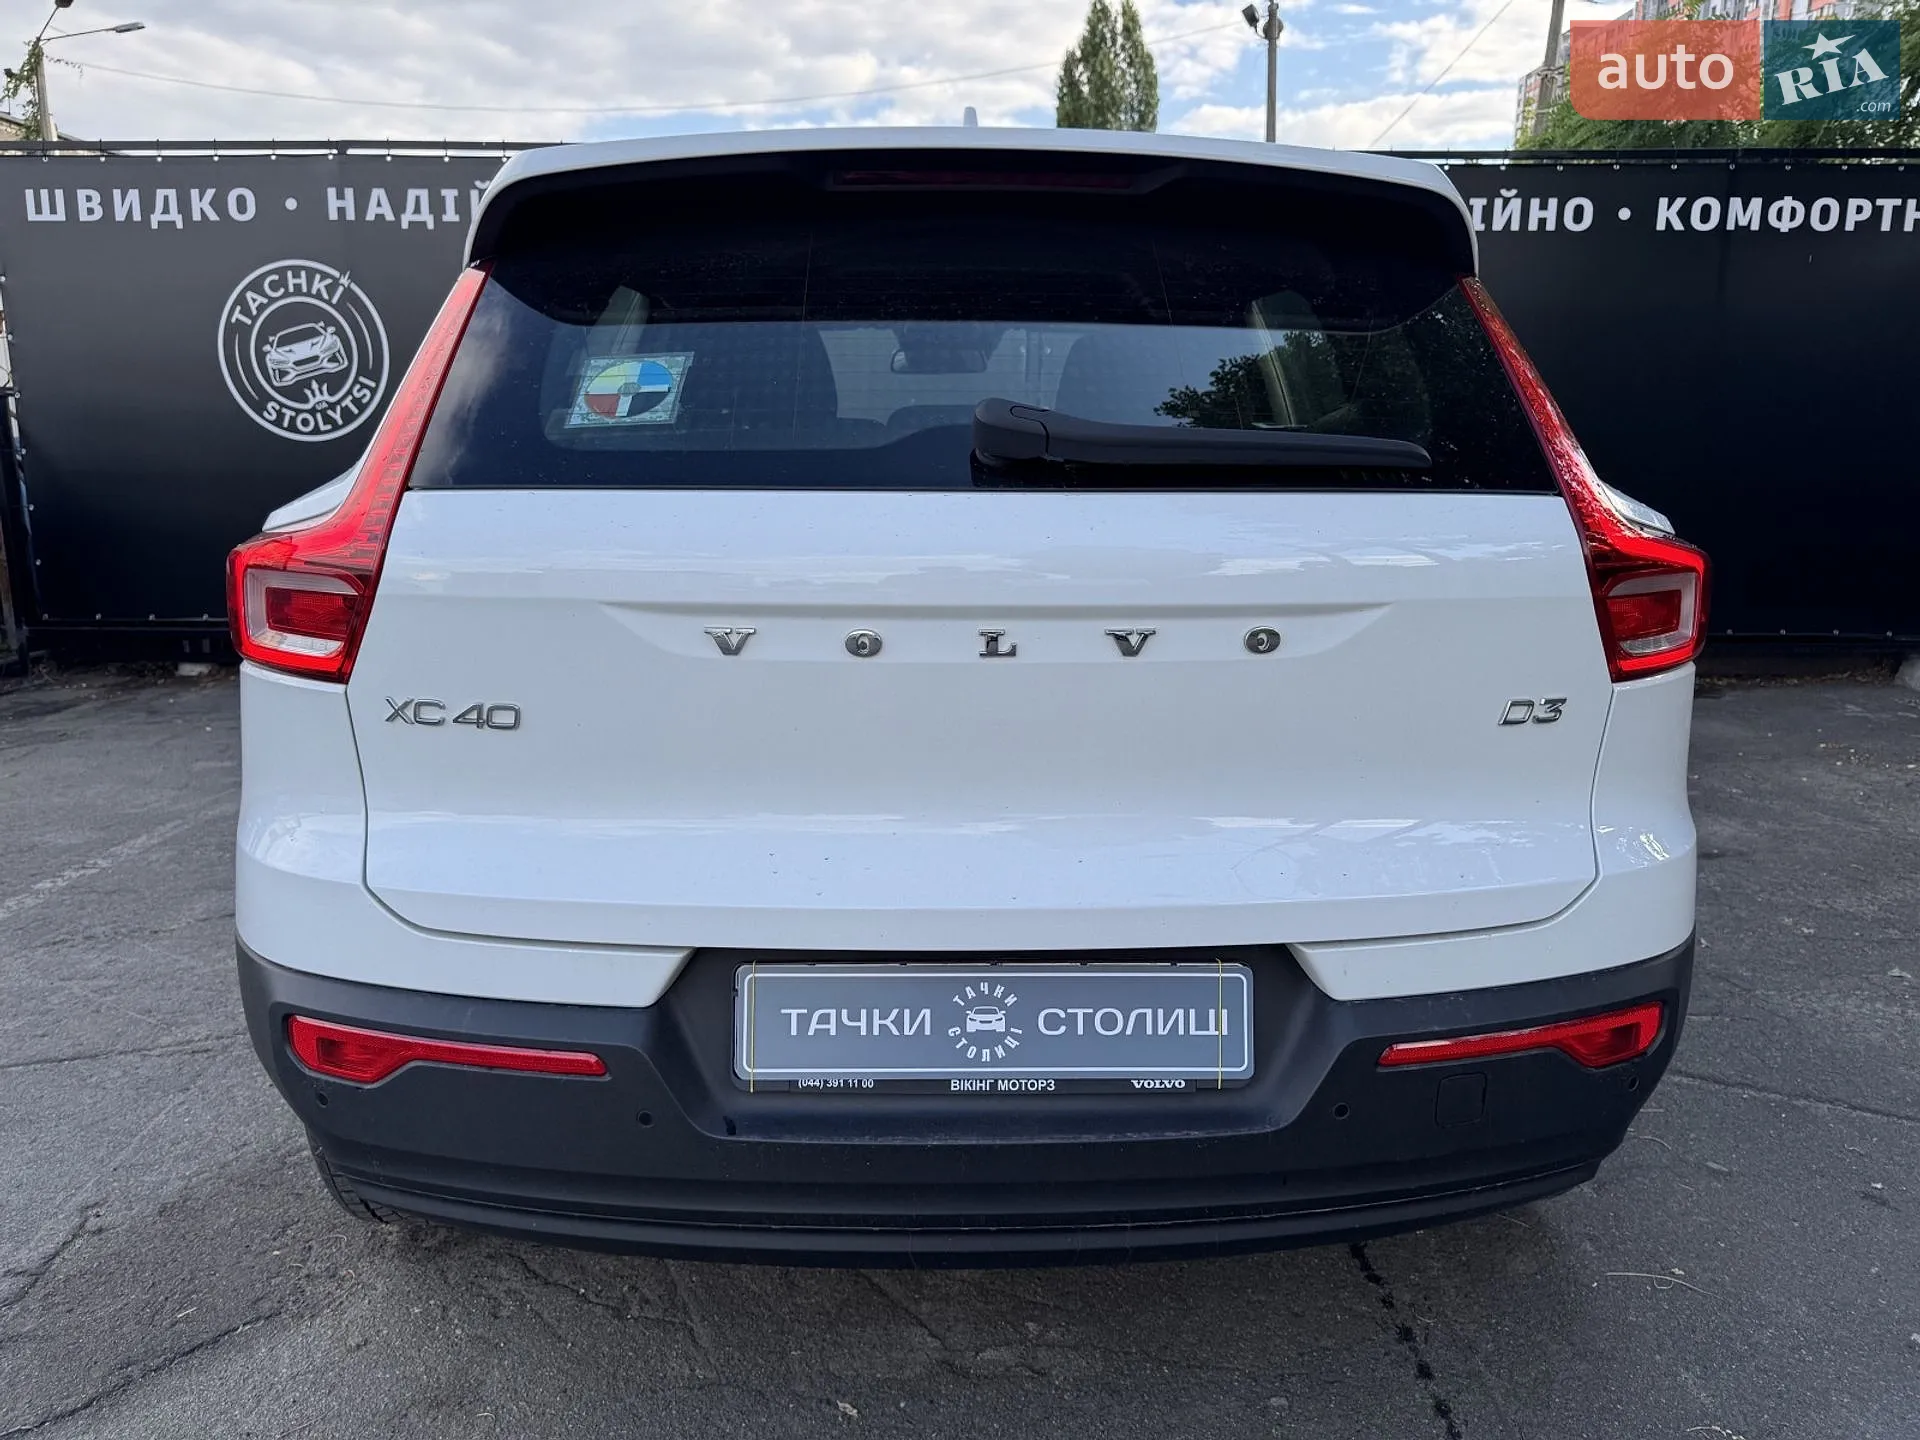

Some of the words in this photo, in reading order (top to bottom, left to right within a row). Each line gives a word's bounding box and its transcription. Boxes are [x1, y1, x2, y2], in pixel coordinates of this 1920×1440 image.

[25, 187, 257, 229] ШВИДКО
[231, 270, 345, 329] TACHKI
[263, 375, 377, 433] STOLYTSI
[704, 625, 1281, 658] VOLVO
[1498, 697, 1568, 725] D3
[953, 982, 1018, 1006] ТАЧКИ
[781, 1008, 931, 1036] ТАЧКИ
[948, 1026, 1023, 1062] СТОЛИЦІ
[861, 1079, 874, 1089] 00
[950, 1079, 994, 1091] ВІКІНГ
[997, 1079, 1055, 1091] МОТОРЗ
[1131, 1079, 1186, 1089] VOLVO
